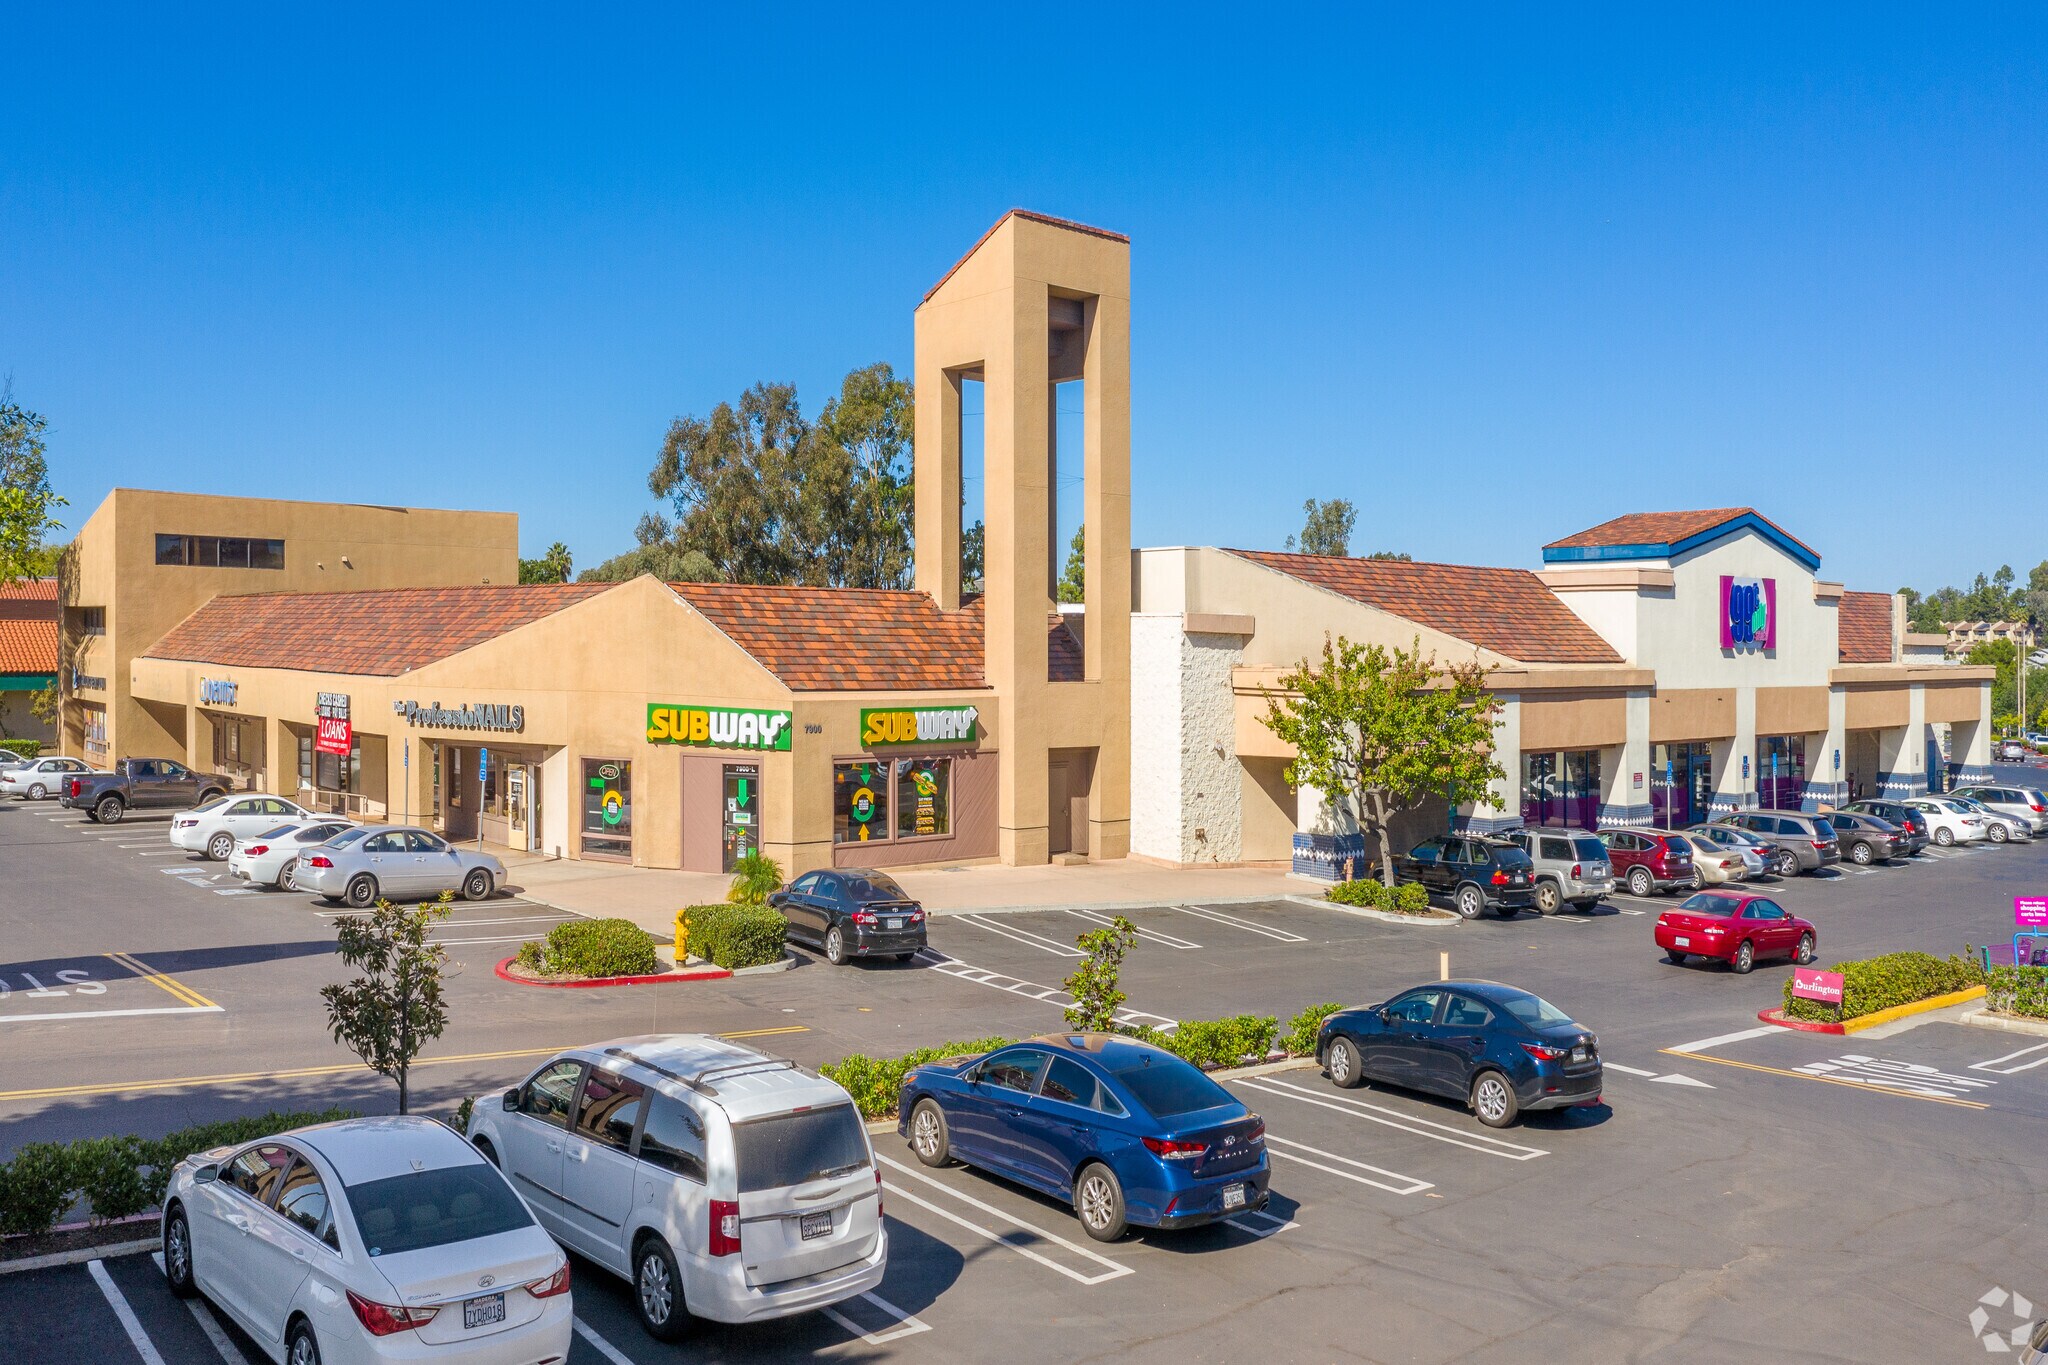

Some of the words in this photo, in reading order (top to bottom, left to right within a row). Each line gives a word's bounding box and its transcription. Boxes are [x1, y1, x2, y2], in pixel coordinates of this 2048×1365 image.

[406, 700, 522, 729] ProfessioNAILS
[646, 708, 790, 745] SUBWAY
[862, 706, 978, 746] SUBWAY
[321, 719, 347, 741] LOANS
[601, 767, 617, 777] OPEN
[0, 969, 107, 1000] ST
[1795, 979, 1840, 996] Burlington
[466, 1303, 503, 1325] 7YDH018
